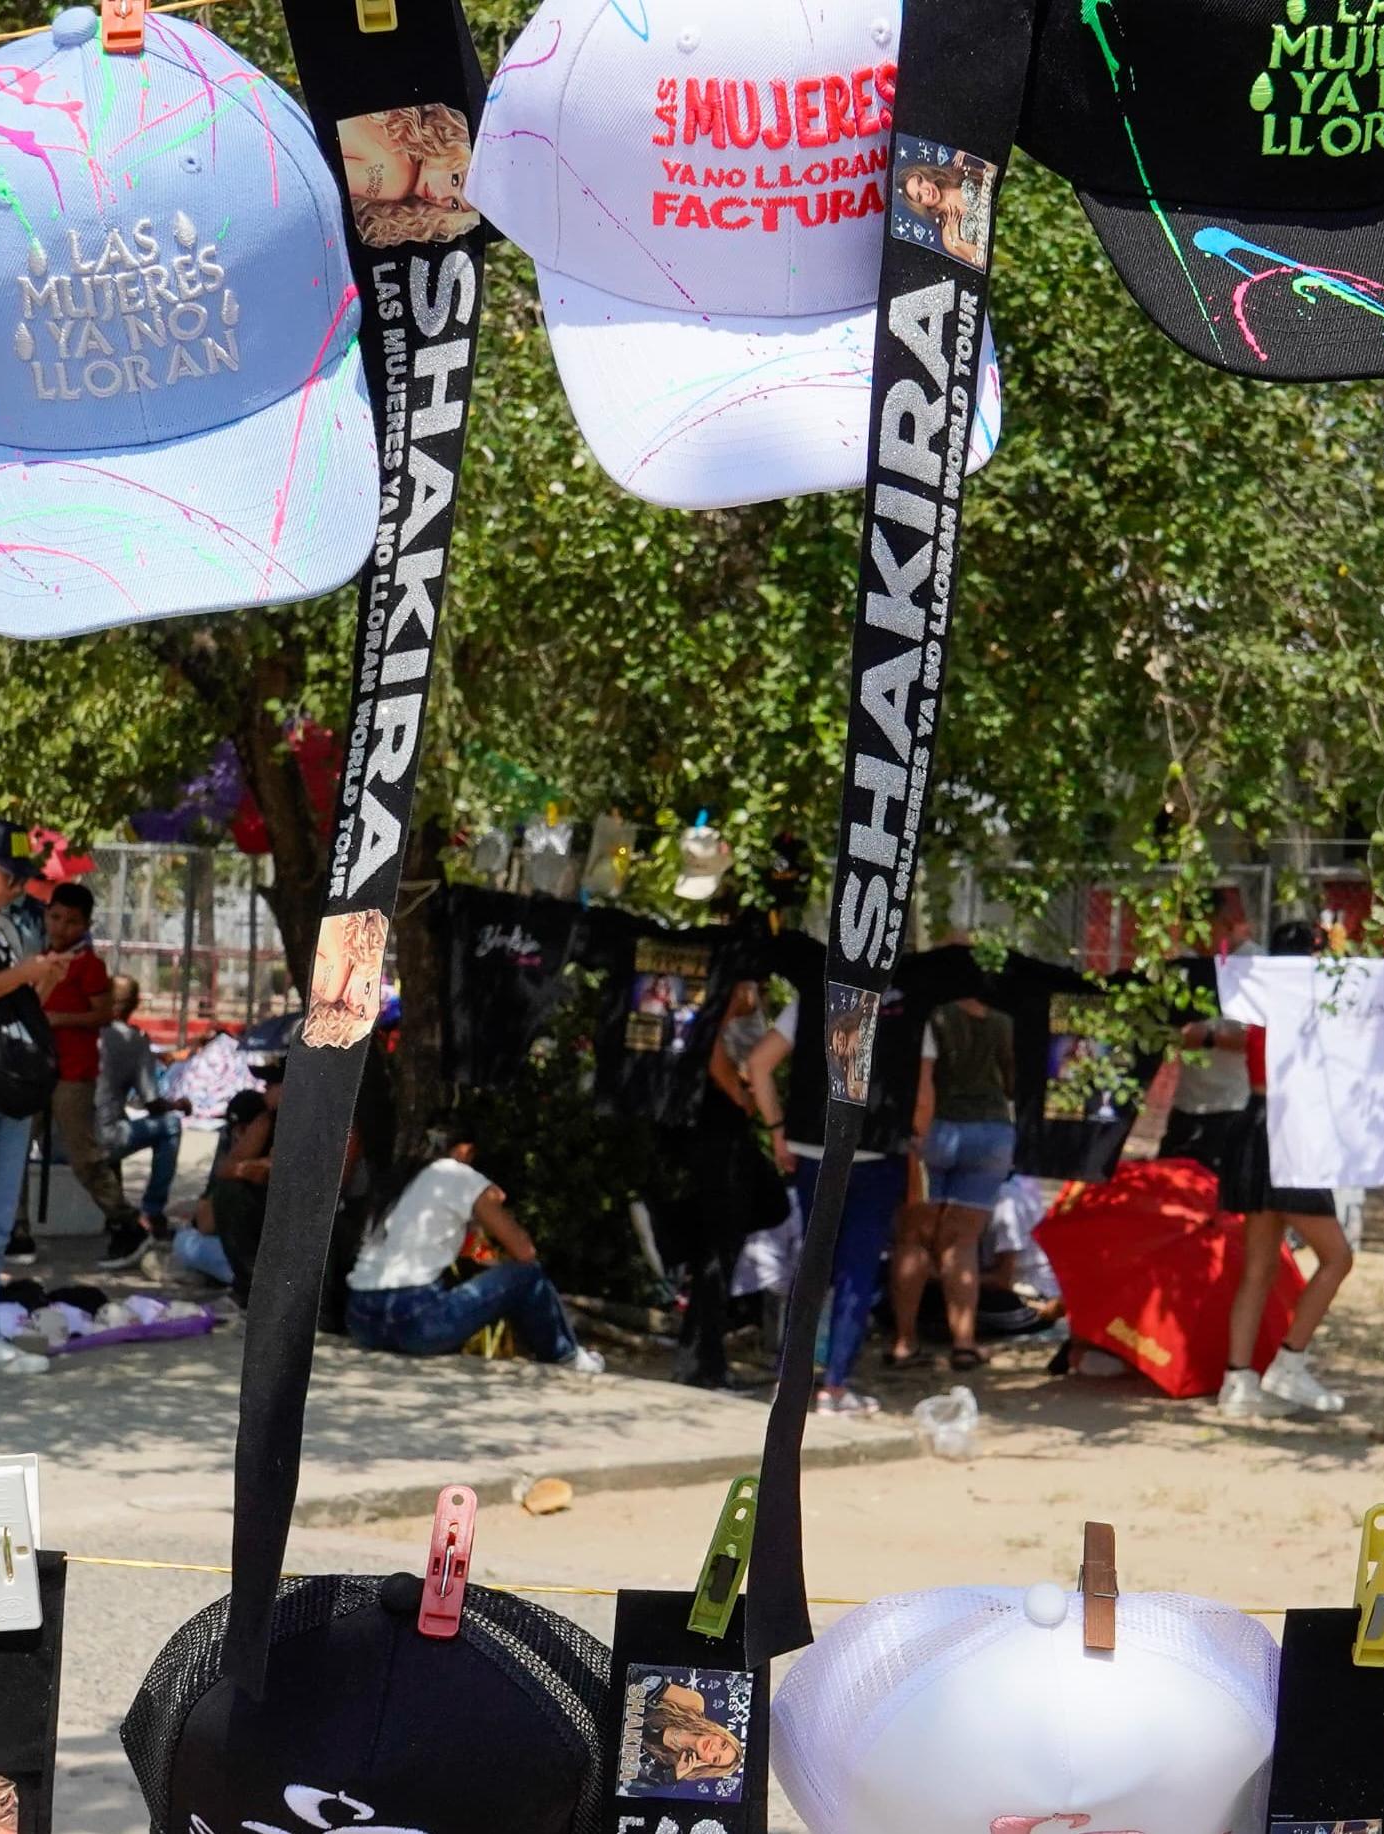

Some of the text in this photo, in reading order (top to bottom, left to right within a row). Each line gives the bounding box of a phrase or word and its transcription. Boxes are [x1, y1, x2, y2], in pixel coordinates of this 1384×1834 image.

[652, 78, 677, 147] LAS
[683, 60, 898, 150] MUJERES
[1290, 71, 1360, 115] YA
[755, 145, 888, 189] LLORAN
[652, 181, 886, 232] FACTURA
[69, 218, 159, 274] LAS
[17, 245, 225, 322] MUJERES
[31, 328, 240, 400] LLORAN
[45, 301, 208, 359] YA NO
[328, 262, 408, 900] LAS MUJERES YA NO LLORAN WORLD TOUR
[346, 249, 476, 900] SHAKIRA
[839, 279, 956, 969] SHAKIRA
[879, 289, 978, 970] LAS MUJERES YA NO LLORAN WORLD TOUR
[619, 1683, 647, 1782] SHAKIRA
